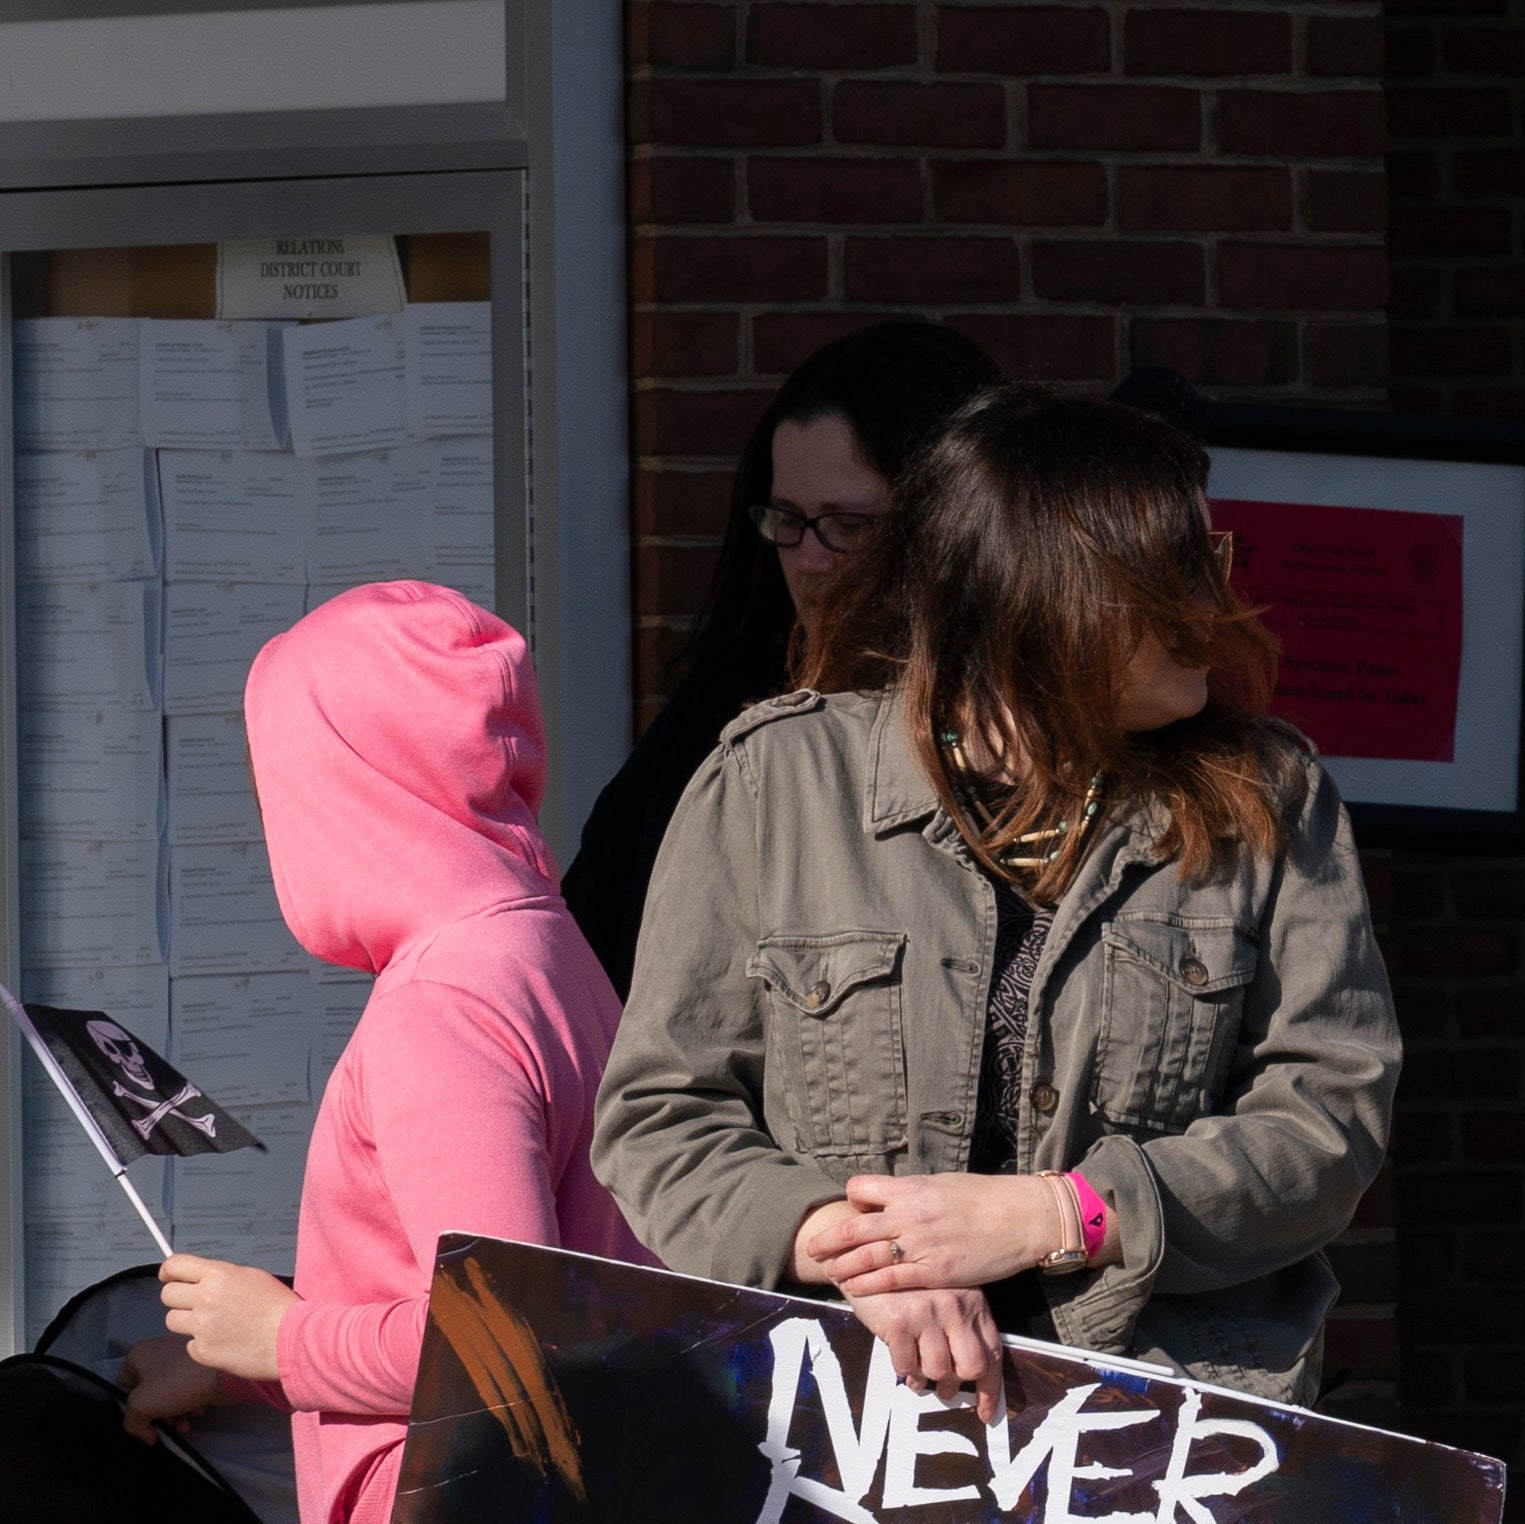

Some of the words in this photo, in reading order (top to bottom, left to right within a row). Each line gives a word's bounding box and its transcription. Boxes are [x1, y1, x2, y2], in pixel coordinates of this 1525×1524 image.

[276, 239, 345, 255] RELATIONS
[261, 262, 318, 277] DISTRICT
[320, 261, 362, 277] COURT
[283, 285, 338, 299] NOTICES
